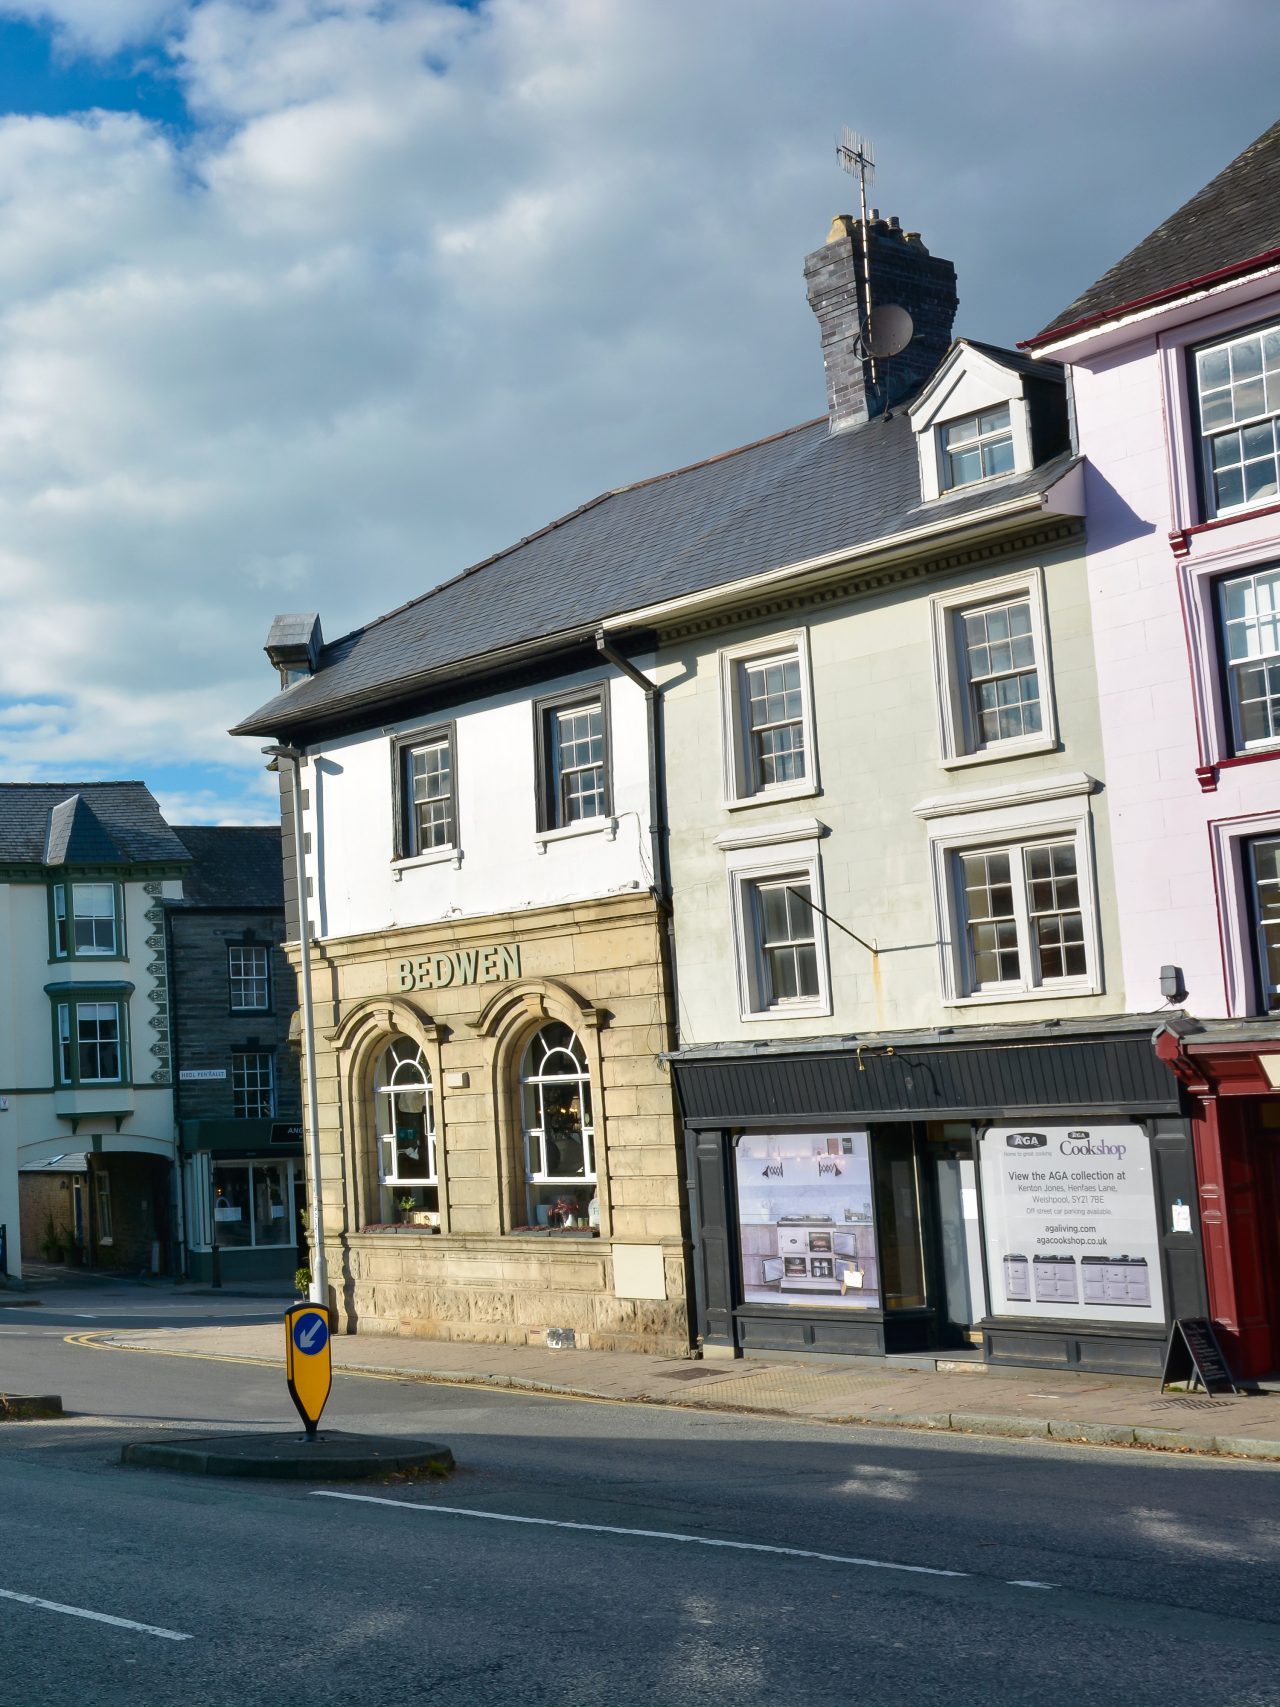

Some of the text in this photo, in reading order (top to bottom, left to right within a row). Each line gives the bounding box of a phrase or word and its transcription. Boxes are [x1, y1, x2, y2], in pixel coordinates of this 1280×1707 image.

[397, 944, 522, 992] BEDWEN
[1015, 1136, 1039, 1145] AGA
[1060, 1139, 1127, 1160] Cookshop
[1008, 1170, 1126, 1181] View the AGA collection at
[1018, 1184, 1042, 1192] Kenton
[1044, 1184, 1065, 1192] Jones,
[1098, 1184, 1118, 1193] Lane,
[1071, 1195, 1088, 1203] SY21
[1091, 1195, 1105, 1203] 7BE
[1045, 1224, 1097, 1233] agaliving.com
[1036, 1236, 1108, 1246] agacookshop.co.uk
